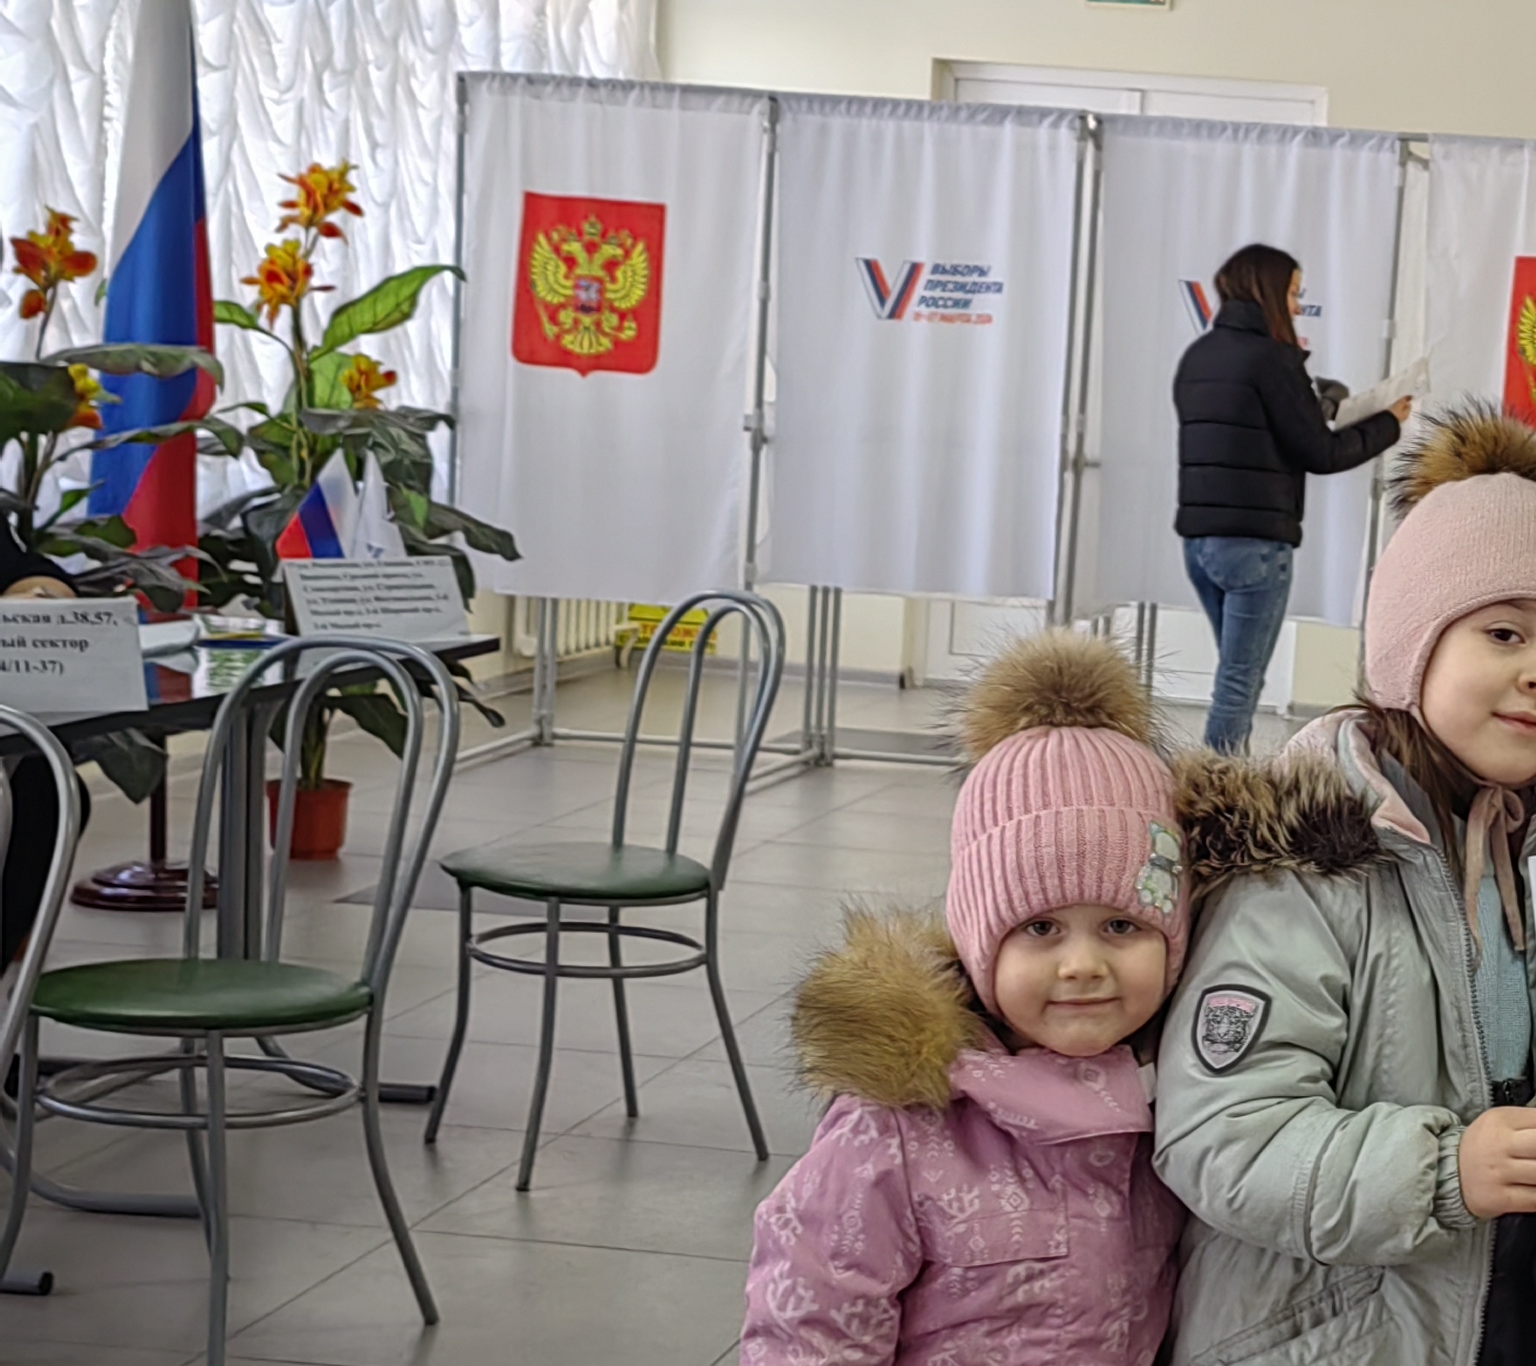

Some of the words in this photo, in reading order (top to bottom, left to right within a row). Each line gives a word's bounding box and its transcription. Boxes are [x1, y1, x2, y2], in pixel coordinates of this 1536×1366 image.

[930, 262, 991, 277] ВЫБОРЫ
[924, 279, 1003, 294] ПРЕЗИДЕНТА
[917, 295, 973, 309] РОССИИ
[32, 638, 89, 652] сектор
